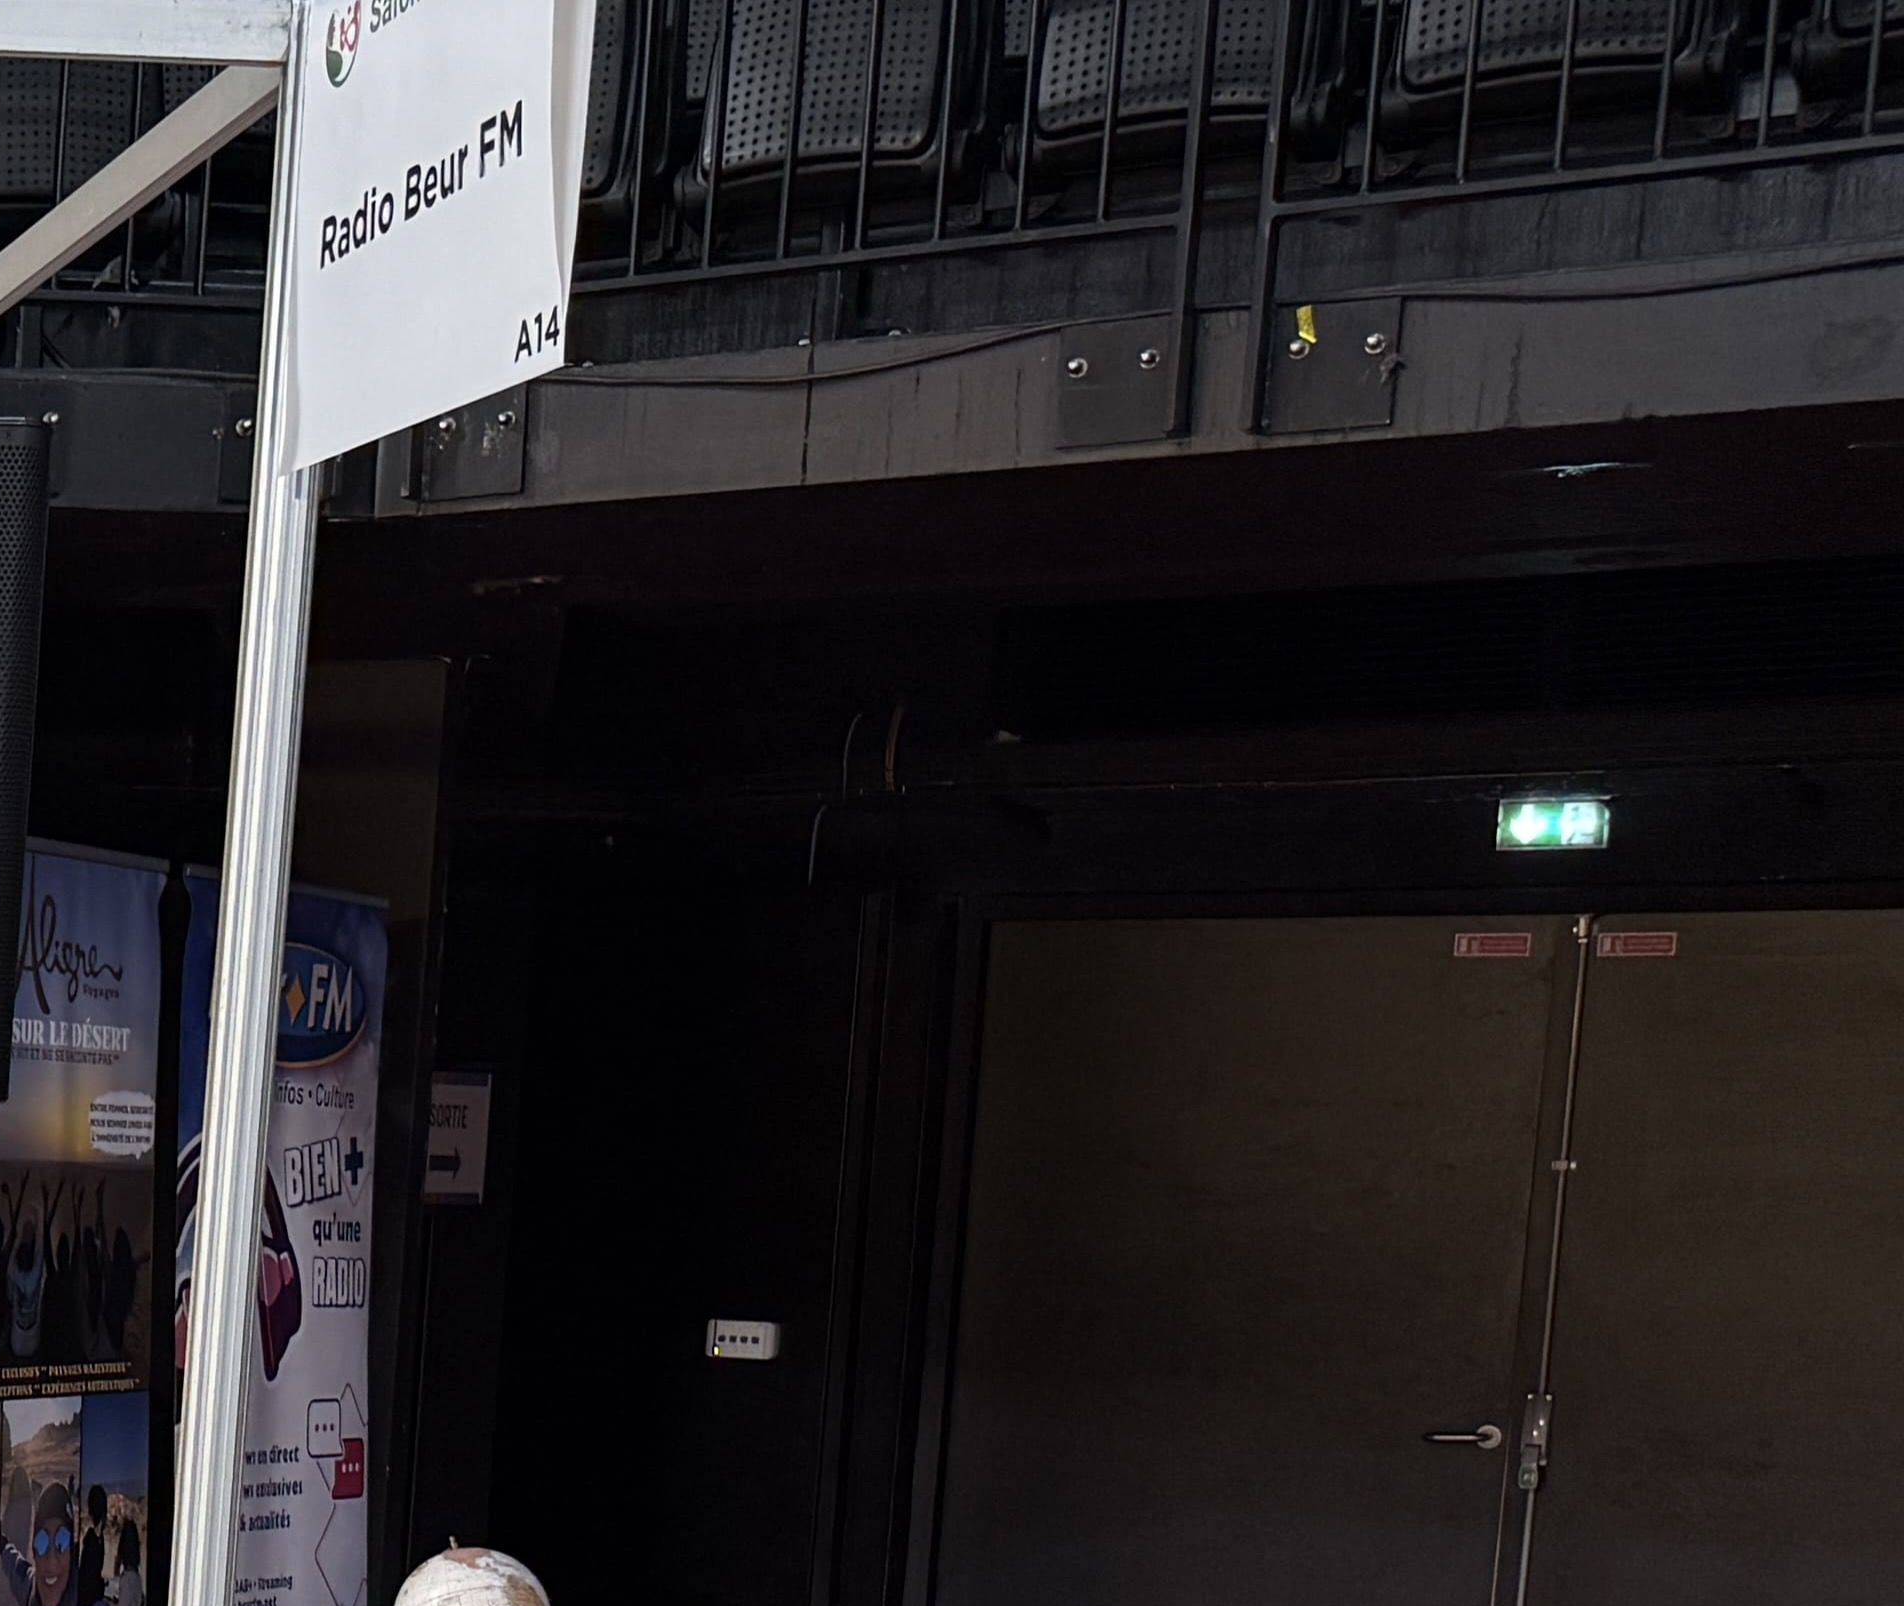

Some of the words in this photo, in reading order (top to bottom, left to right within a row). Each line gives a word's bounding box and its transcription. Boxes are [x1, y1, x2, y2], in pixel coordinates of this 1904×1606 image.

[320, 187, 395, 270] Radio
[404, 143, 469, 222] Beur
[479, 100, 524, 178] FM
[514, 305, 561, 364] A14
[307, 963, 352, 1033] FM
[12, 1017, 44, 1046] SUR
[50, 1021, 69, 1046] LE
[72, 1017, 131, 1052] DÉSERT
[278, 1080, 304, 1105] nfos
[316, 1082, 355, 1109] Culture
[429, 1103, 468, 1129] SORTIE
[284, 1136, 342, 1207] BIEN
[312, 1257, 366, 1308] RADIO
